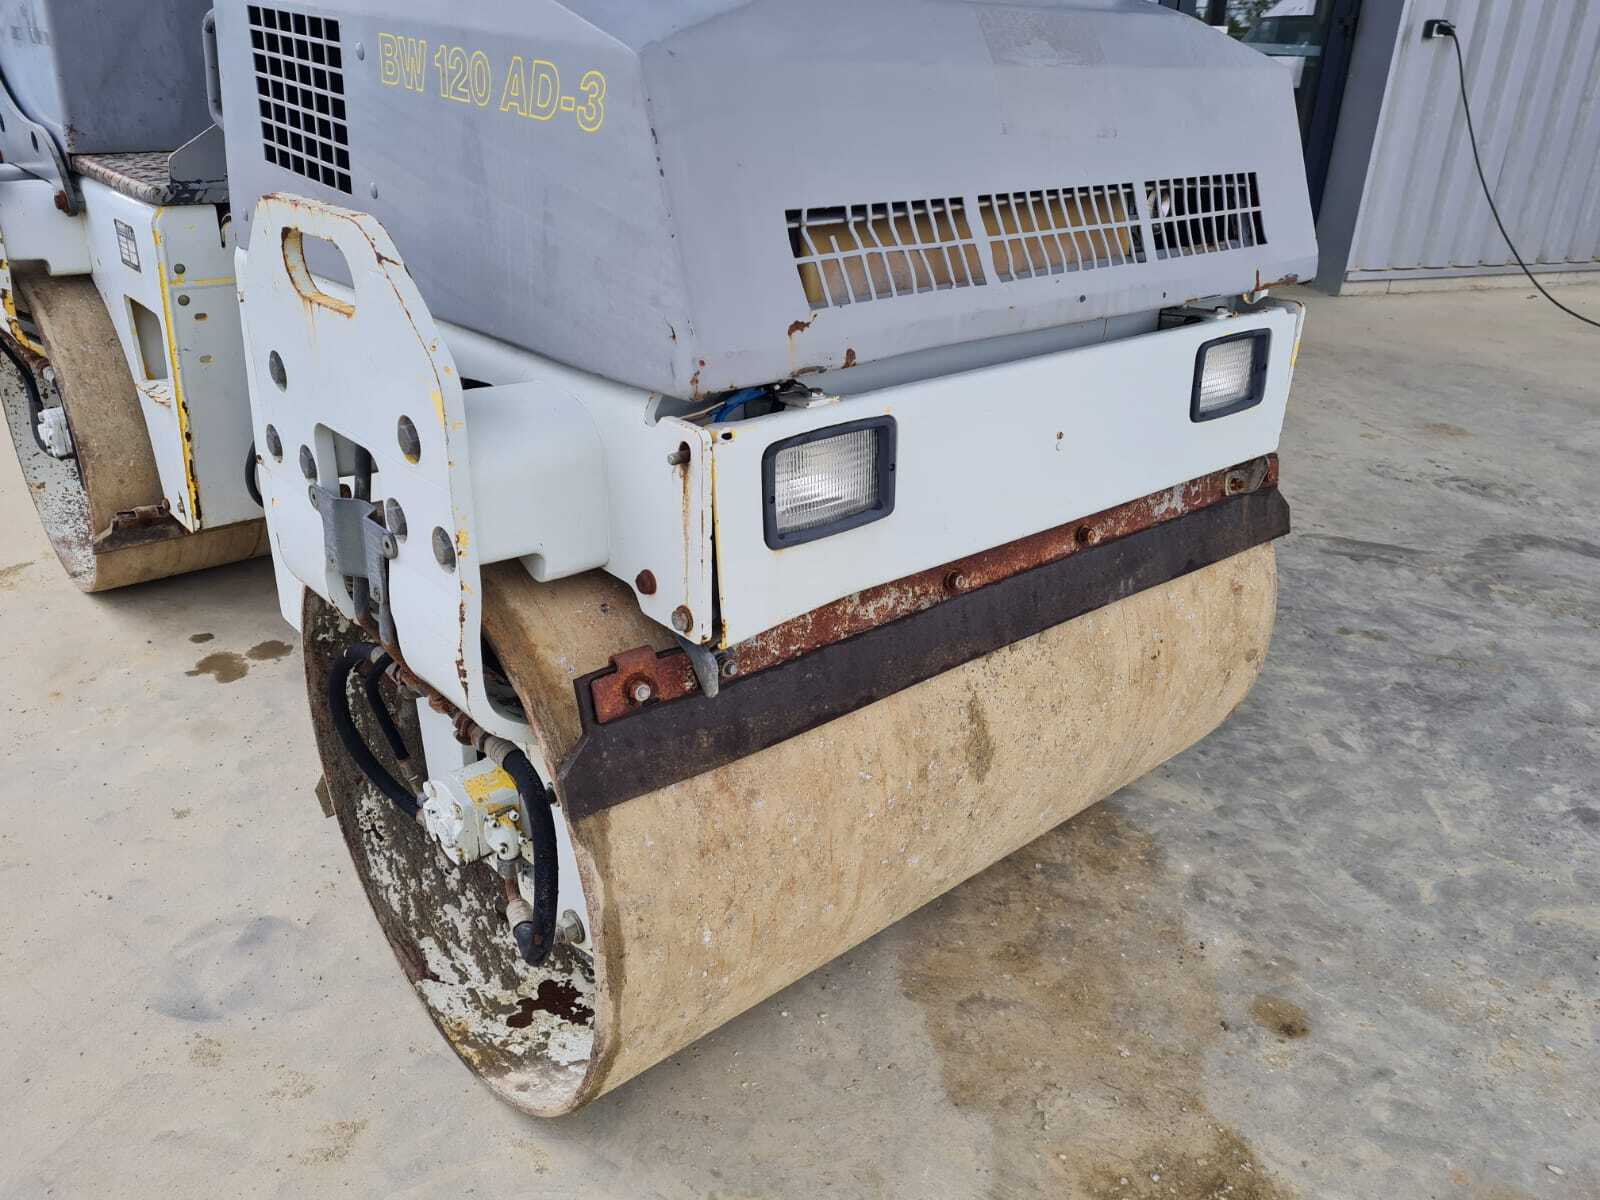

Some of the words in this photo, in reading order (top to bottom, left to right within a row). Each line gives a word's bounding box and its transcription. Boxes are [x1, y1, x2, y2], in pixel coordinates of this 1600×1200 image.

[378, 32, 427, 92] BW
[434, 44, 492, 106] 120
[500, 56, 606, 132] AD-3
